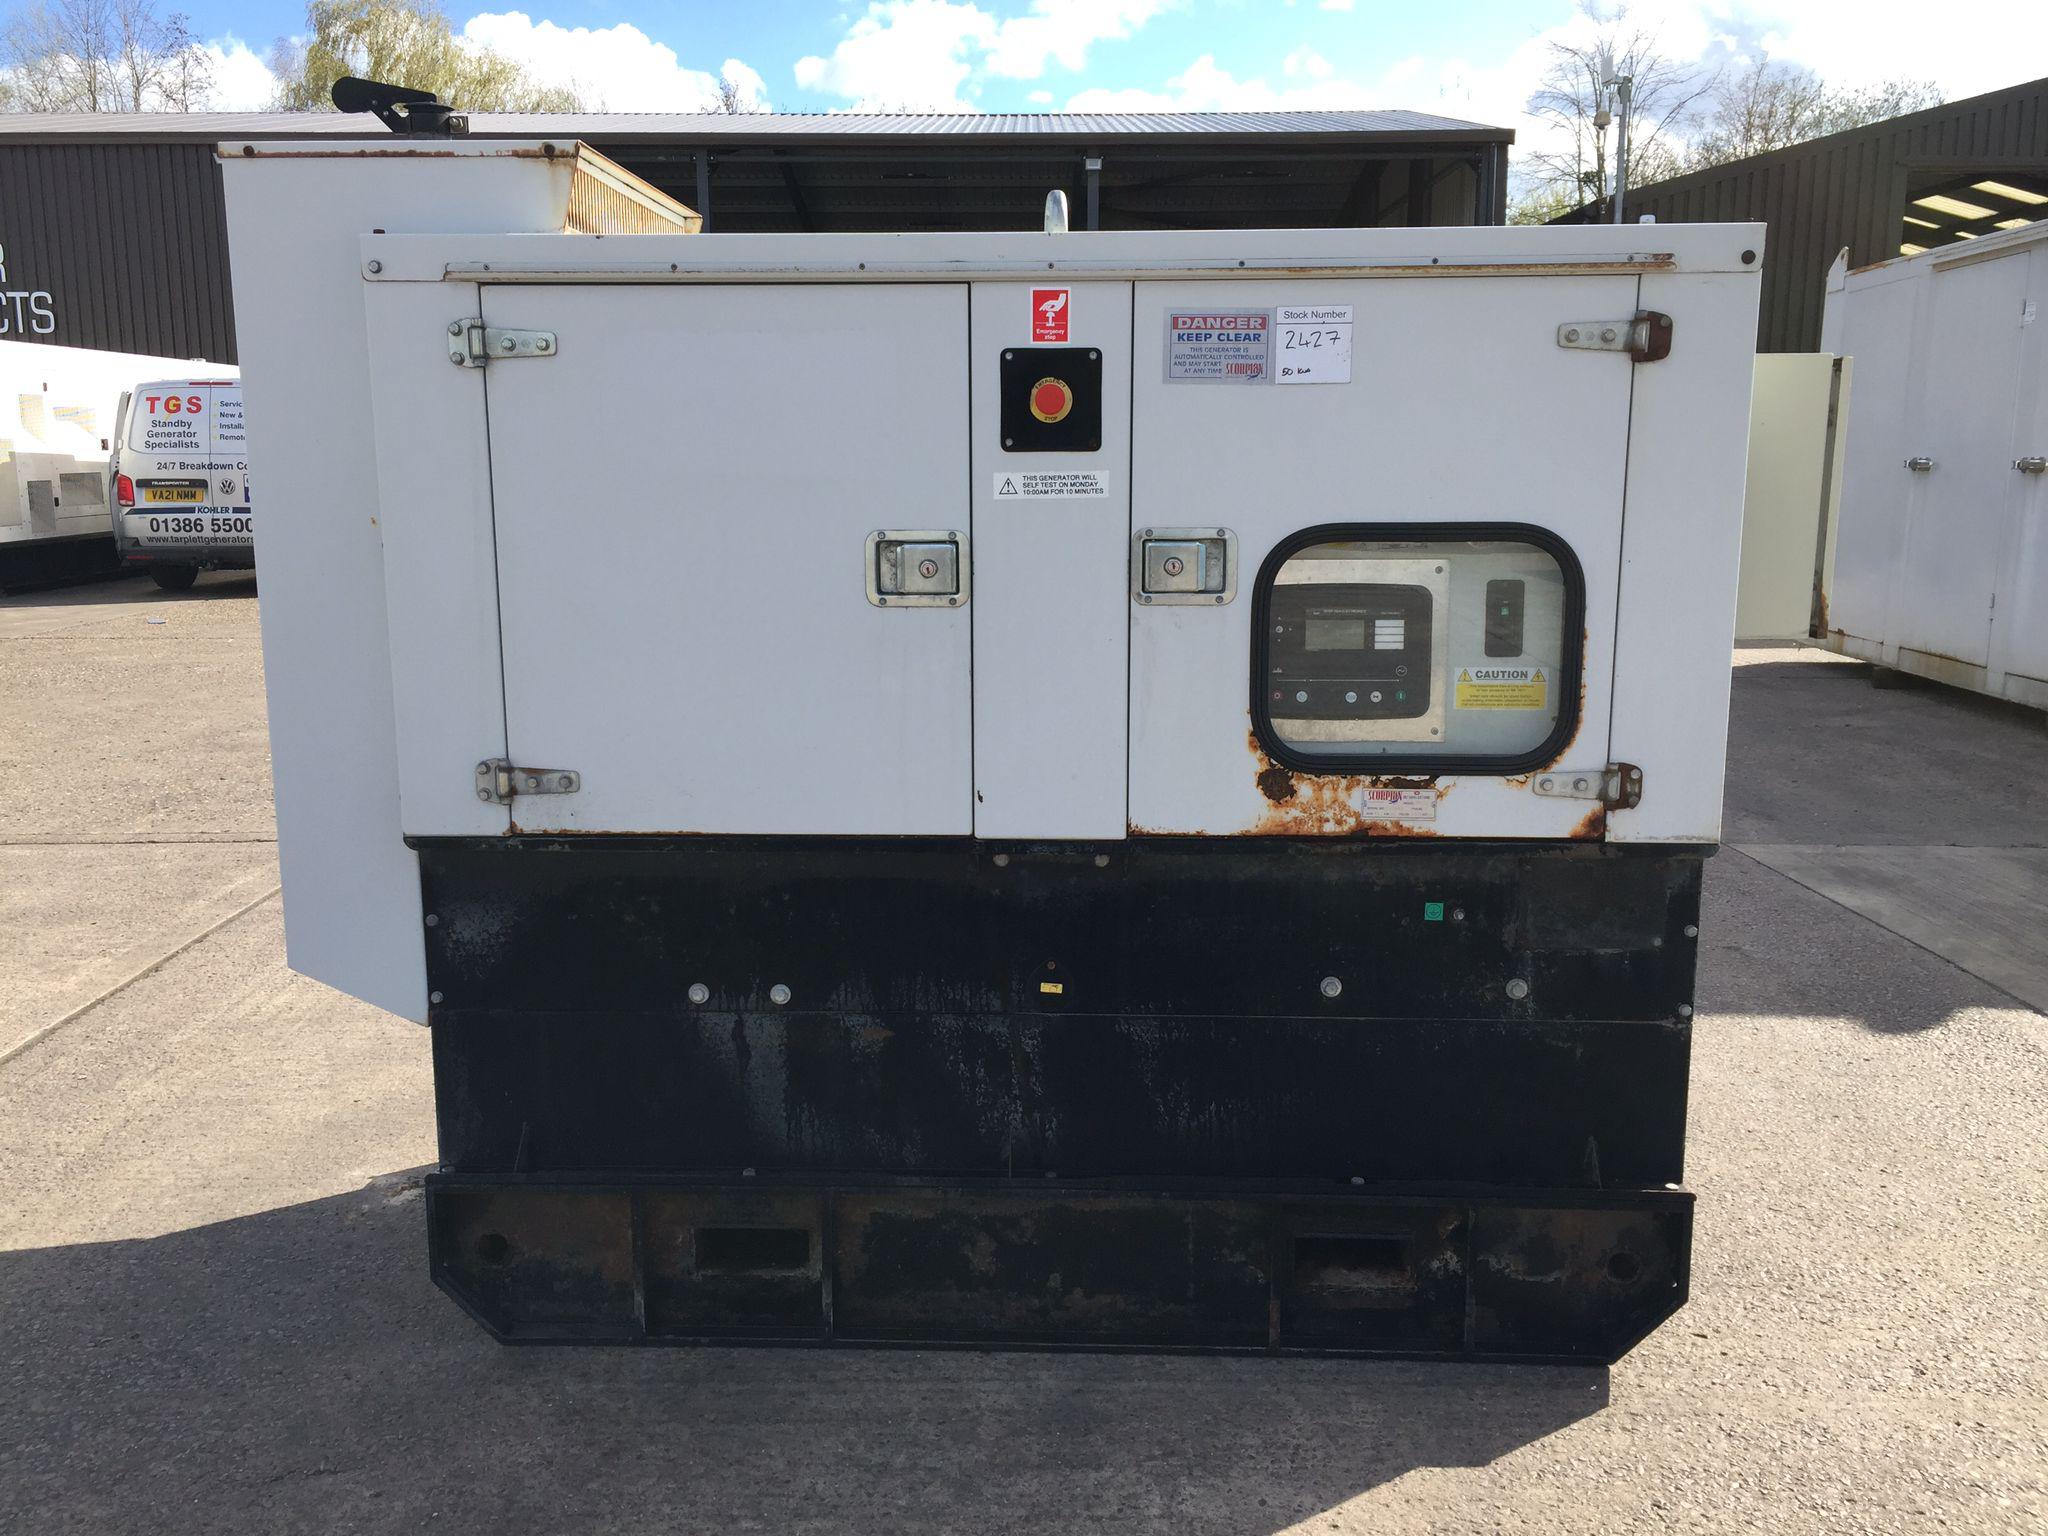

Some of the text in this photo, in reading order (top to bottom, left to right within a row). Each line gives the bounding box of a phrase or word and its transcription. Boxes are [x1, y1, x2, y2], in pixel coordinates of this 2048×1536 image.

[1283, 310, 1347, 319] Stock Number
[1177, 317, 1262, 329] DANGER
[1177, 333, 1261, 342] KEEP CLEAR
[1285, 330, 1341, 349] 2427
[1281, 367, 1294, 377] 50
[145, 395, 203, 414] TGS
[151, 420, 192, 429] Standby
[146, 430, 197, 438] Generator
[144, 440, 200, 450] Specialists
[156, 462, 176, 471] 24/7
[179, 462, 234, 470] Breakdown
[151, 489, 174, 500] VA21
[149, 518, 204, 533] 01386
[1475, 670, 1528, 679] CAUTION
